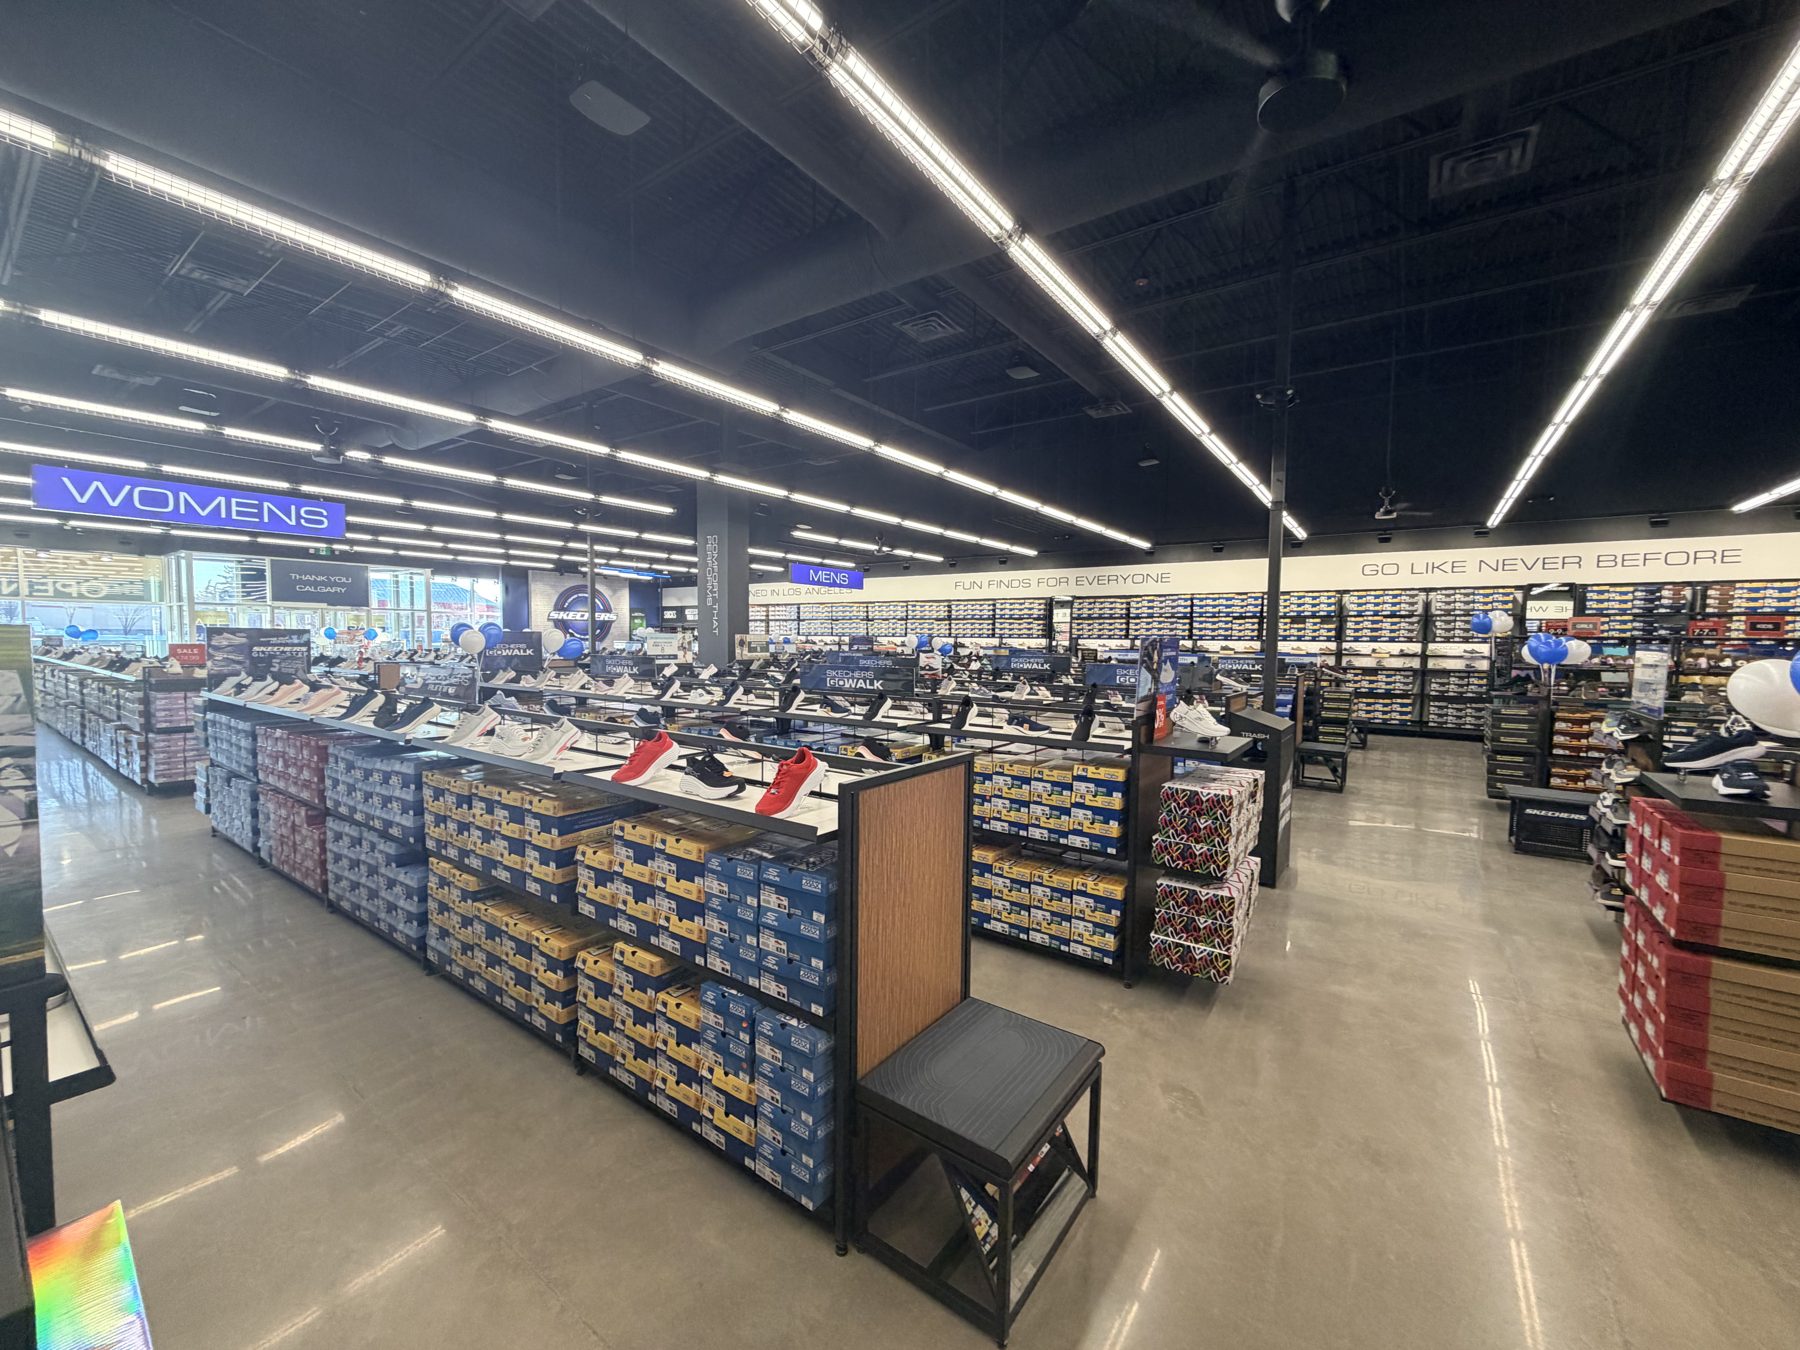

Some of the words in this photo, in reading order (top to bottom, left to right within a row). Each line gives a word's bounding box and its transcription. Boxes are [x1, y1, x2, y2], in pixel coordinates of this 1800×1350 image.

[61, 477, 329, 529] WOMENS
[1361, 562, 1400, 577] GO
[1410, 560, 1468, 575] LIKE
[1478, 555, 1583, 573] NEVER
[1596, 548, 1743, 569] BEFORE
[289, 573, 328, 583] THANK
[328, 575, 352, 584] YOU
[809, 569, 849, 585] MENS
[954, 581, 983, 591] FUN
[987, 578, 1032, 589] FINDS
[1037, 576, 1070, 588] FOR
[1075, 572, 1172, 587] EVERYONE
[296, 584, 347, 594] CALGARY
[770, 589, 780, 597] IN
[782, 587, 802, 597] LOS
[548, 611, 618, 621] SKECERS
[826, 669, 875, 679] SKECHERS
[826, 677, 884, 690] GOWALK
[1240, 731, 1271, 740] TRASH
[1523, 807, 1589, 821] SKECHERS
